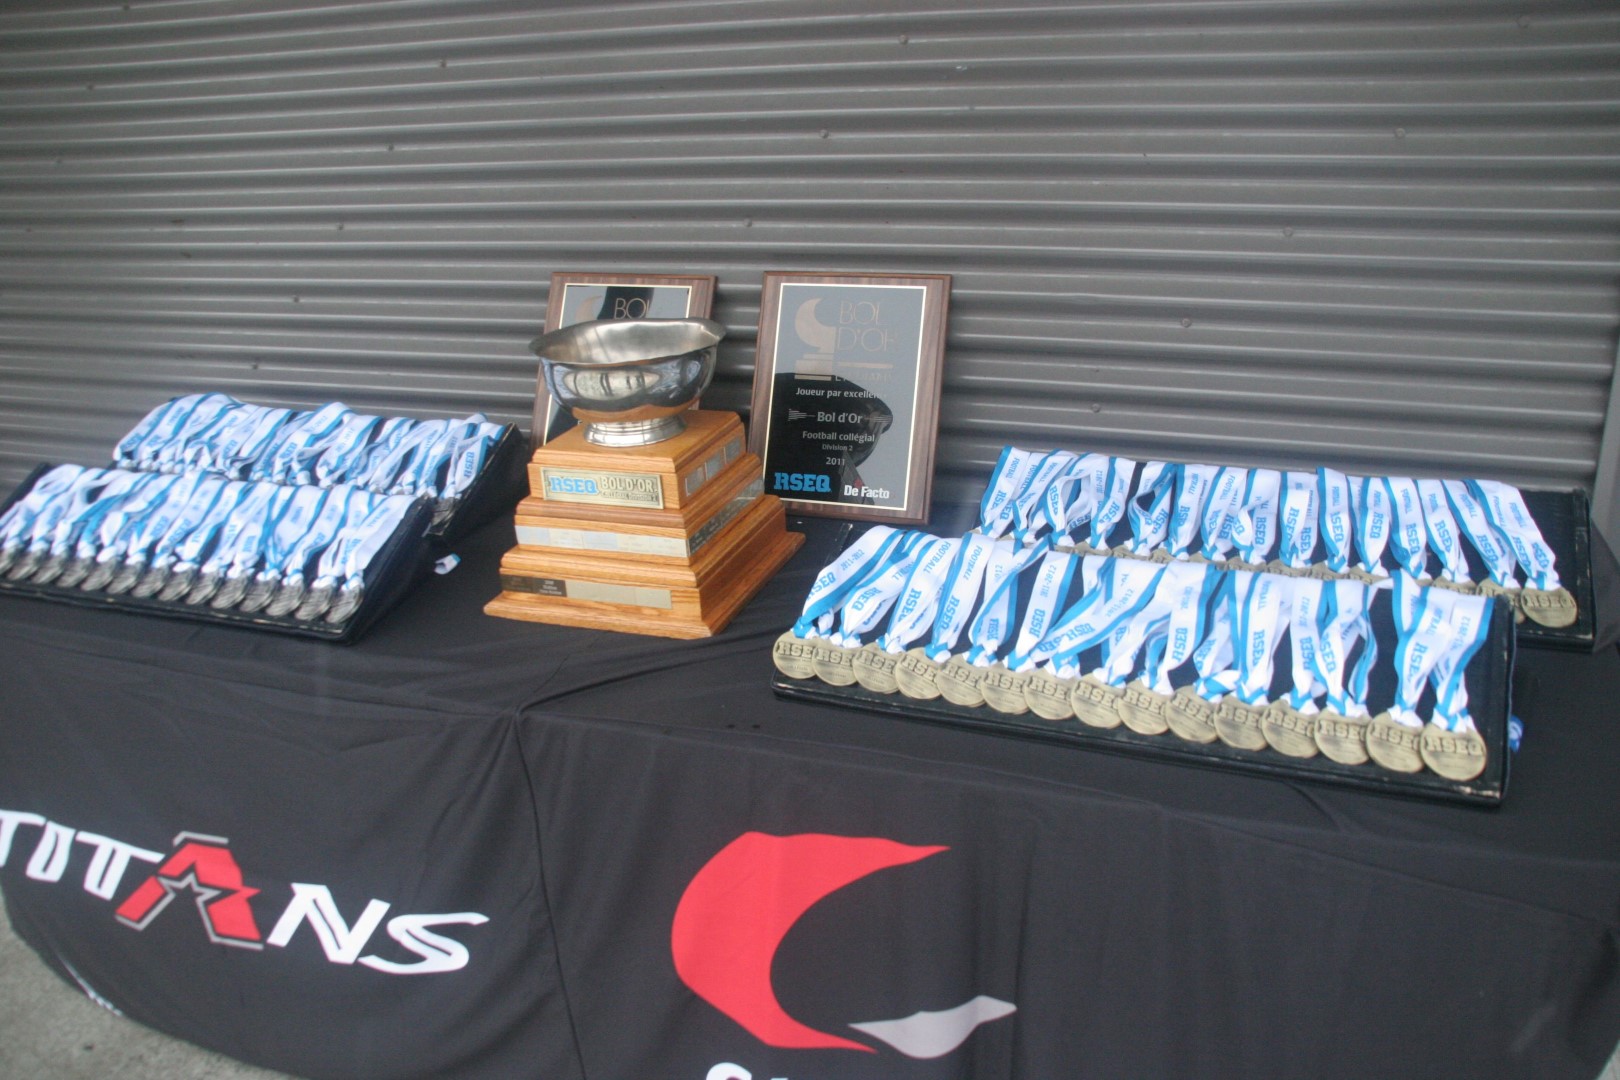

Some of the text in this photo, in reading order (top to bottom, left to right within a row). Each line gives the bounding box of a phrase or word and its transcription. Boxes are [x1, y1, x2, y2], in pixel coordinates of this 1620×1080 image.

[839, 301, 888, 326] BOL
[796, 387, 884, 399] Joueur par excellen
[817, 411, 863, 424] Bol d'Or
[802, 430, 876, 444] Football collégial
[821, 443, 854, 452] Division 2
[825, 456, 846, 466] 2011
[549, 477, 599, 495] RSEQ
[600, 476, 624, 491] BOL
[773, 472, 831, 493] RSEQ
[843, 485, 890, 500] De Facto
[1254, 516, 1267, 546] RSEQ
[1369, 511, 1384, 539] RSEQ
[1406, 522, 1420, 555] RSEQ
[1476, 534, 1500, 564] RSEQ
[922, 541, 952, 574] FOOTBALL
[962, 544, 983, 581] FOOTBALL
[852, 587, 884, 612] RSEQ
[1028, 608, 1047, 638] RSEQ
[777, 641, 814, 657] RSE
[815, 647, 852, 665] RSE
[1172, 627, 1188, 662] RSEQ
[858, 650, 896, 674] RSE
[901, 654, 937, 682] RSE
[943, 664, 982, 690] RSE
[983, 671, 1024, 693] RSE
[1027, 675, 1070, 701] RSE
[0, 809, 490, 975] TITANS
